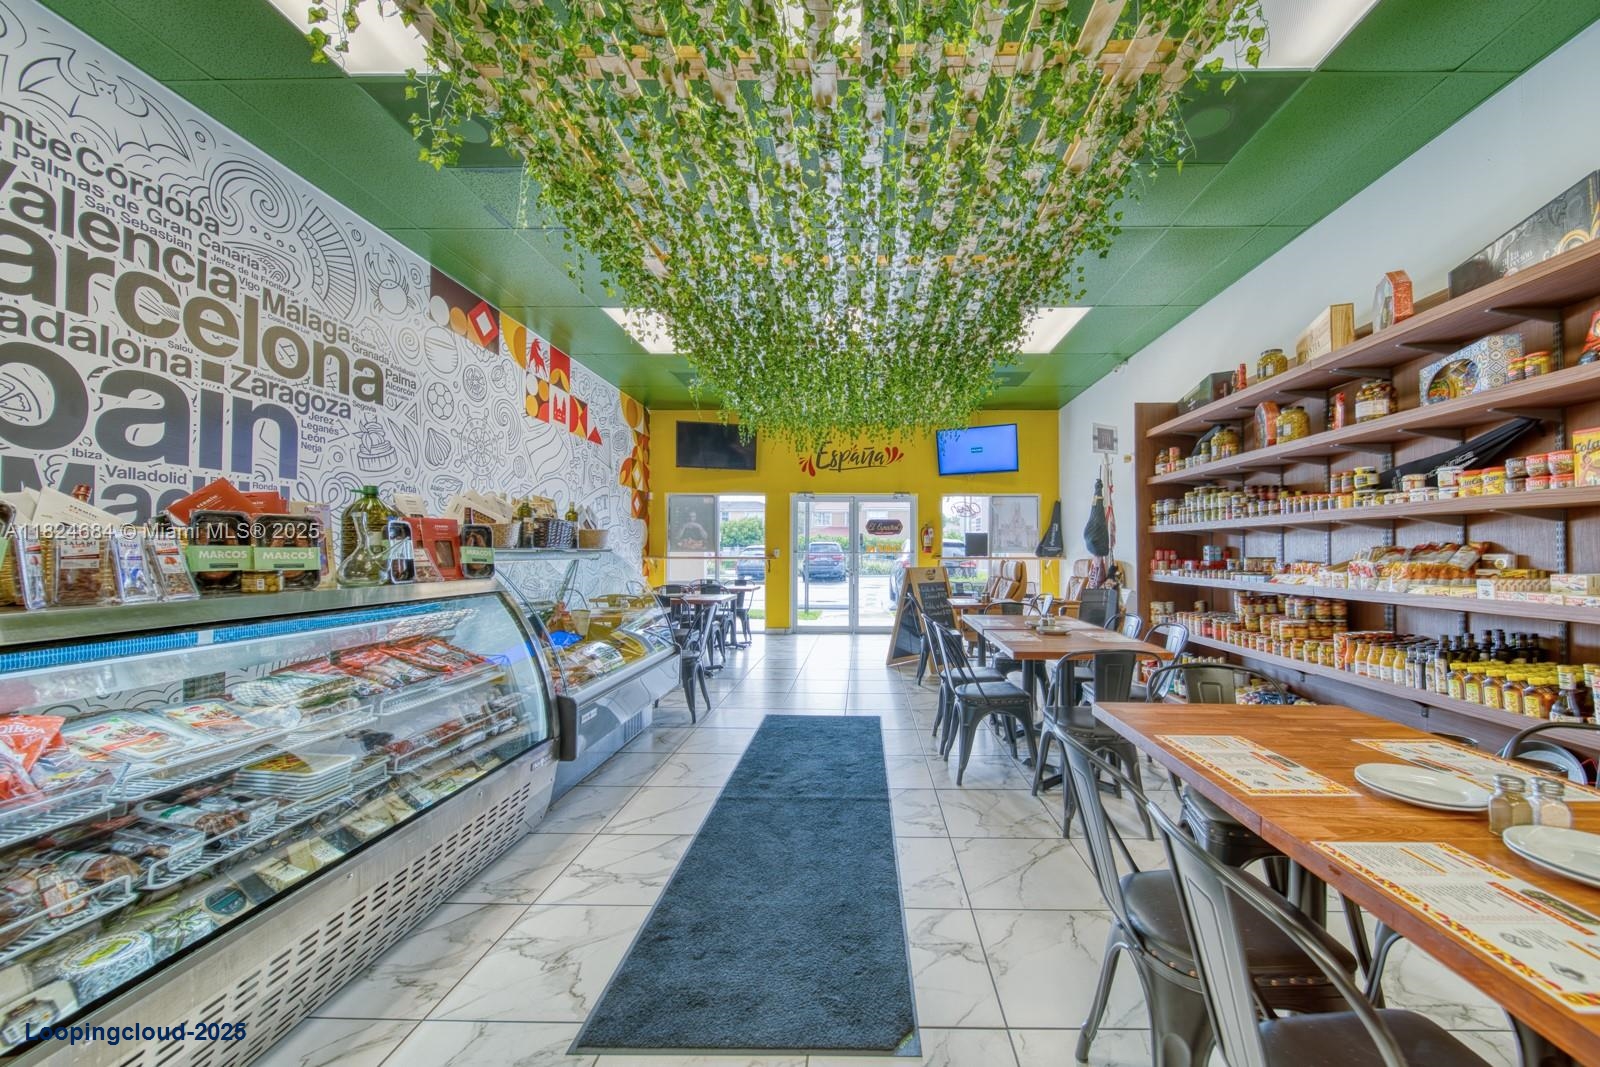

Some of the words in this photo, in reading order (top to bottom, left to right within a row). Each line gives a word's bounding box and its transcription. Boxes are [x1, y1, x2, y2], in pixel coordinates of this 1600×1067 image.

[76, 146, 220, 236] Córdoba
[13, 141, 105, 199] Palmas
[112, 193, 139, 214] de
[146, 207, 193, 240] Gran
[199, 232, 259, 271] Canaria
[84, 193, 115, 218] San
[120, 210, 193, 252] Sebastian
[210, 253, 236, 272] Jerez
[238, 264, 250, 277] de
[251, 270, 259, 282] la
[260, 275, 295, 297] Frontera
[238, 275, 261, 293] Vigo
[262, 287, 350, 344] Málaga
[167, 339, 194, 354] Salou
[352, 342, 390, 365] Granada
[385, 368, 417, 390] Palma
[230, 364, 351, 420] Zaragoza
[385, 381, 416, 398] Alcorcón
[308, 411, 335, 426] Jerez
[301, 421, 340, 437] Leganés
[301, 430, 326, 445] León
[72, 447, 103, 461] Ibiza
[301, 441, 322, 453] Nerja
[816, 441, 886, 472] España
[105, 464, 188, 486] Valladolid
[252, 482, 278, 491] Ronda
[199, 550, 248, 560] MARCOS
[263, 552, 315, 560] MARCOS
